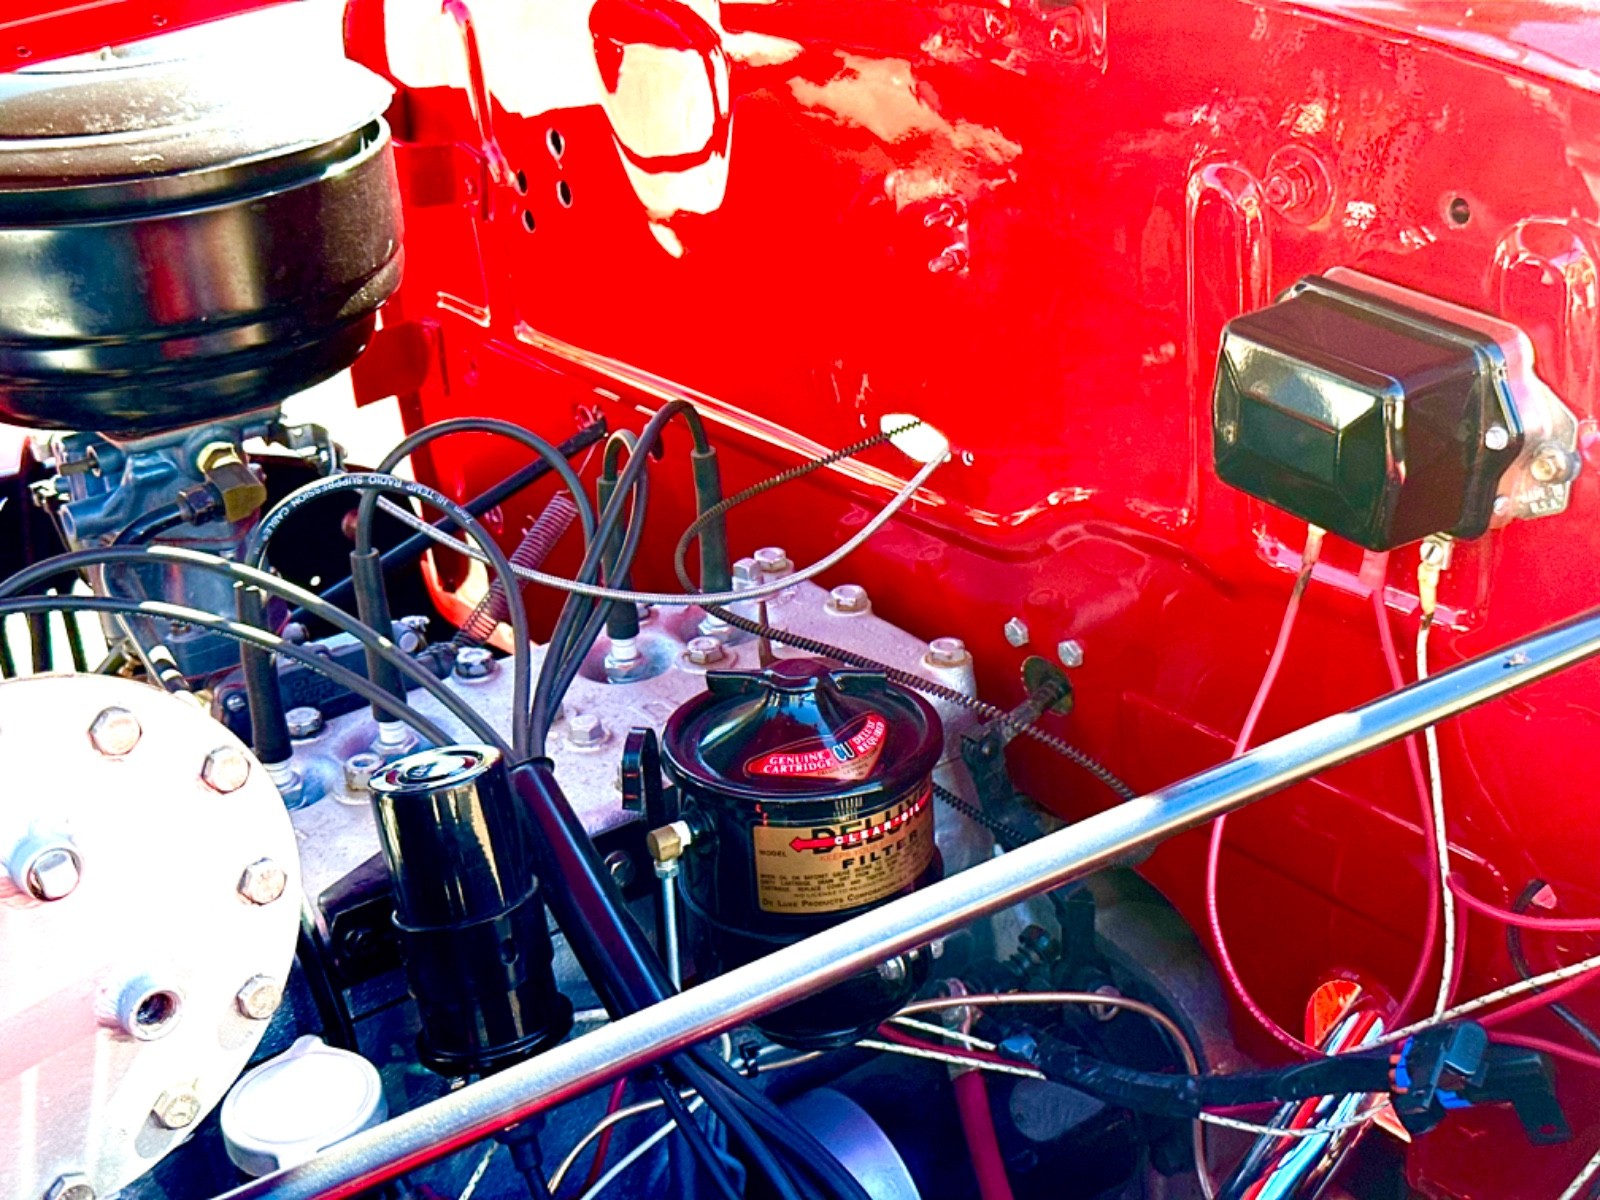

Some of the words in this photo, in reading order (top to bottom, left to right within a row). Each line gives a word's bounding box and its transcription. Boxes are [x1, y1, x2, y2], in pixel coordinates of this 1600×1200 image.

[369, 475, 402, 488] RADIO
[291, 476, 363, 508] SUPPRESSION
[769, 751, 825, 765] GENUINE
[763, 758, 834, 774] CARTRIDGE
[759, 850, 787, 858] MODEL
[842, 829, 918, 869] FILTER
